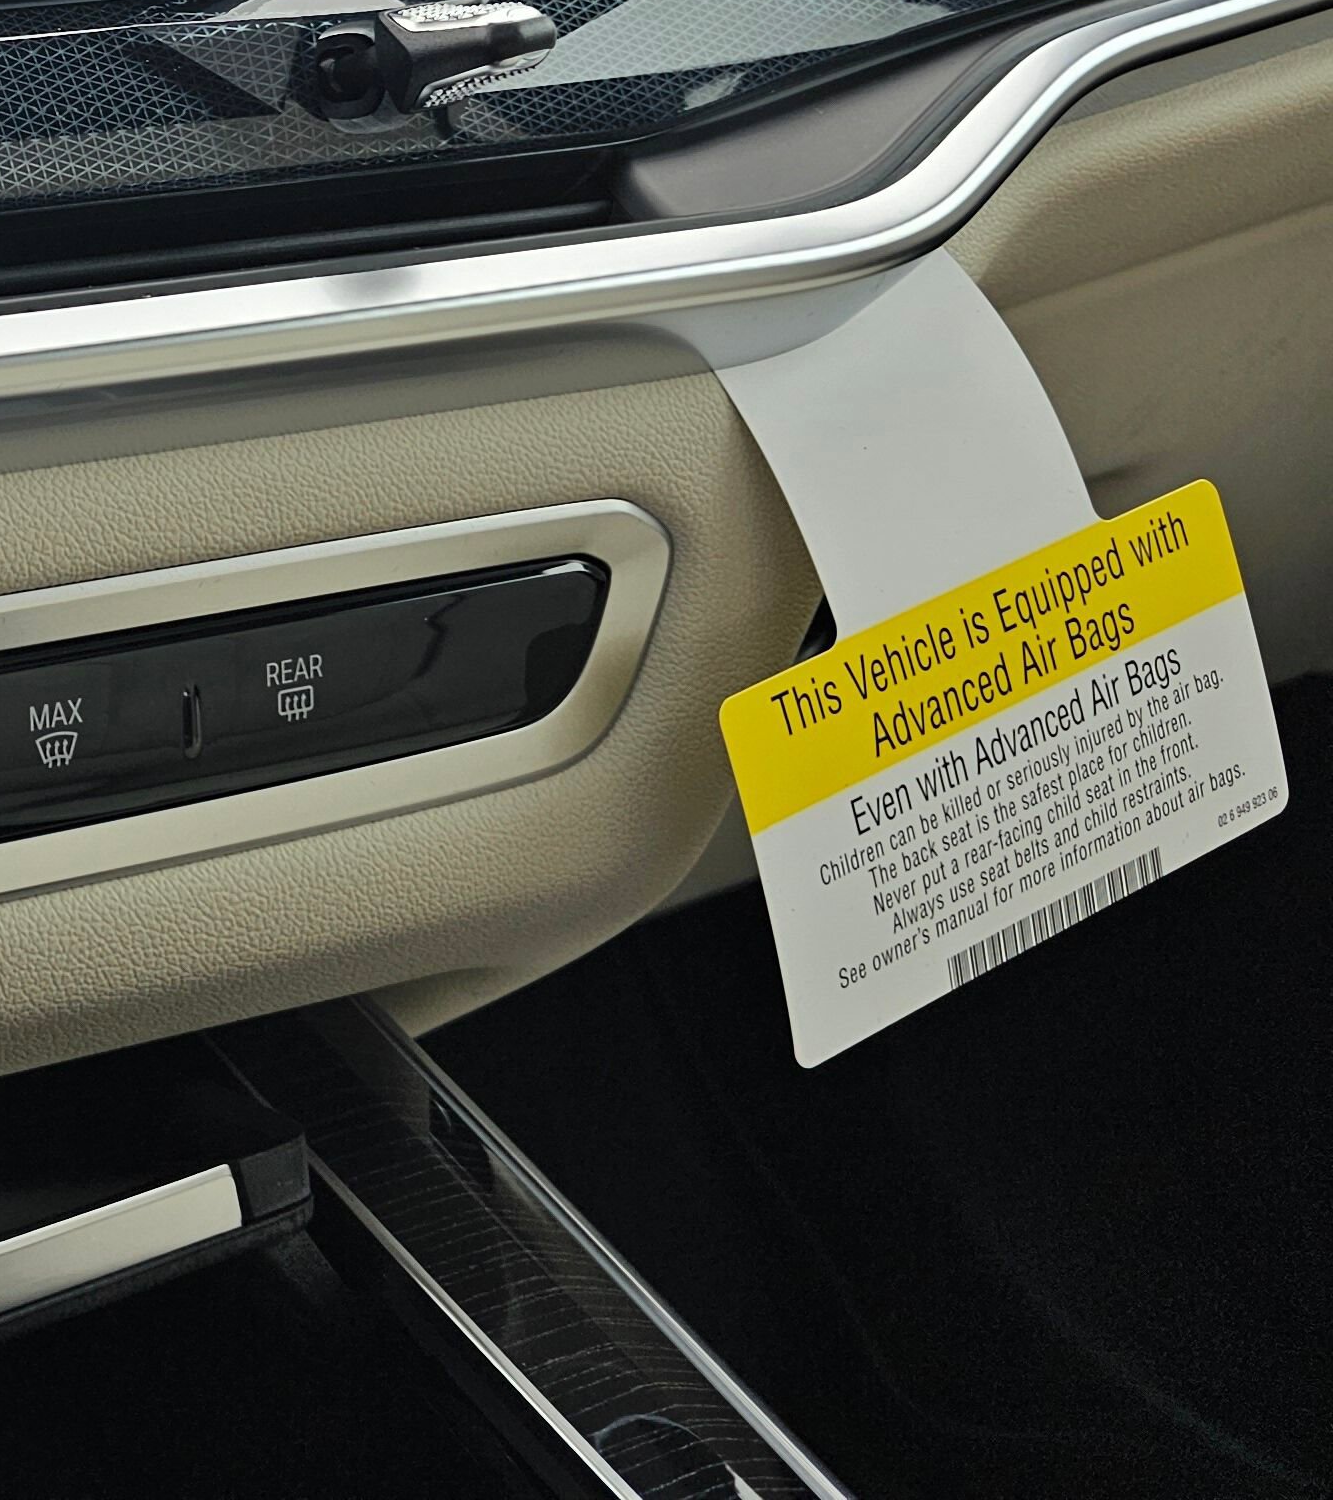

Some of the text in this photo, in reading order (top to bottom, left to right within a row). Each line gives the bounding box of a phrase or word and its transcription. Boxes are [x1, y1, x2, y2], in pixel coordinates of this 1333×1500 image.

[265, 653, 322, 687] REAR
[770, 511, 1189, 736] This Vehicle is Equipped with
[872, 602, 1134, 758] Advanced Air Bags
[30, 698, 83, 731] MAX
[819, 669, 1223, 885] Children can be killed or seriously injured by the air bag.
[849, 648, 1181, 836] Even with Advanced Air Bags
[867, 712, 1191, 888] The back seat is the safest place for children.
[838, 763, 1245, 988] See owner's manual for more information about air bags.
[872, 732, 1198, 915] Never put a rear-facing child seat in the front.
[893, 765, 1191, 934] Always use seat belts and child restraints.
